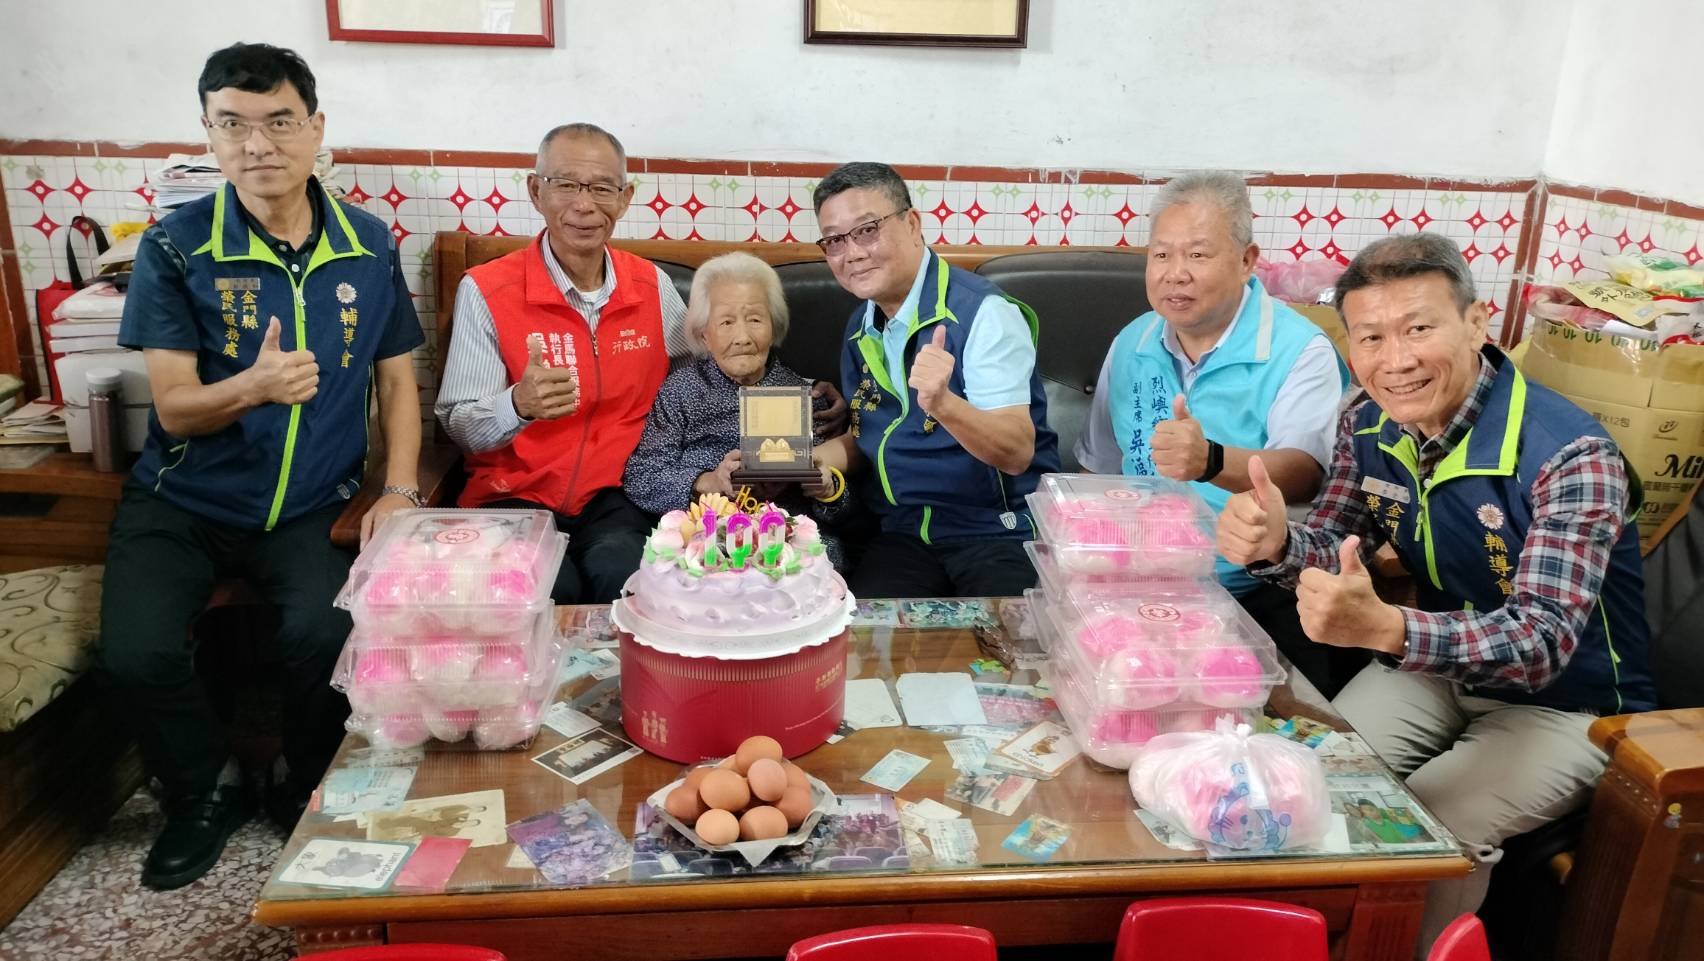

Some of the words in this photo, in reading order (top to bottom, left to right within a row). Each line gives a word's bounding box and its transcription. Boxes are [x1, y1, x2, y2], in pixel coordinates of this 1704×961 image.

[220, 290, 241, 358] 榮民服務處
[241, 290, 259, 330] 金門縣
[339, 307, 359, 368] 輔導會
[549, 332, 564, 366] 執行長
[702, 509, 786, 568] 100
[1484, 531, 1514, 595] 輔導會
